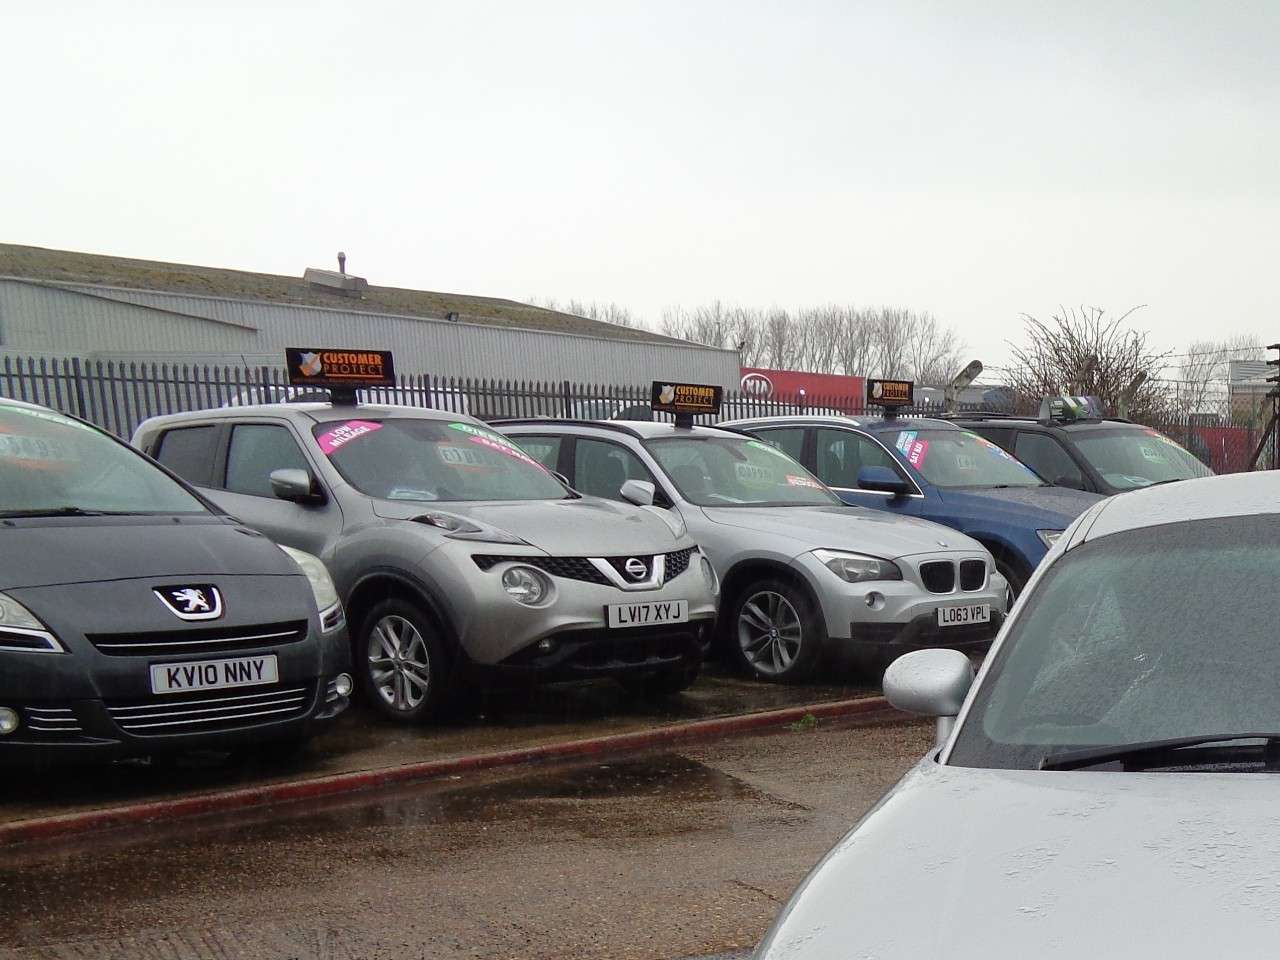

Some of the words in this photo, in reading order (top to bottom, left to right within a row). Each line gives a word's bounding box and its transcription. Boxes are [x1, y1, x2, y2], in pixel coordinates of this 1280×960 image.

[323, 353, 382, 365] CUSTOMER
[323, 364, 385, 375] PROTECT
[676, 386, 714, 397] CUSTOMER
[675, 395, 713, 405] PROTECT
[329, 425, 352, 437] LOW
[329, 426, 371, 447] MILEAGE
[618, 605, 650, 624] LV17
[654, 602, 681, 621] XYJ
[943, 607, 968, 623] LO63
[970, 605, 987, 620] VPL
[167, 664, 218, 688] KV10
[224, 659, 264, 683] NNY
